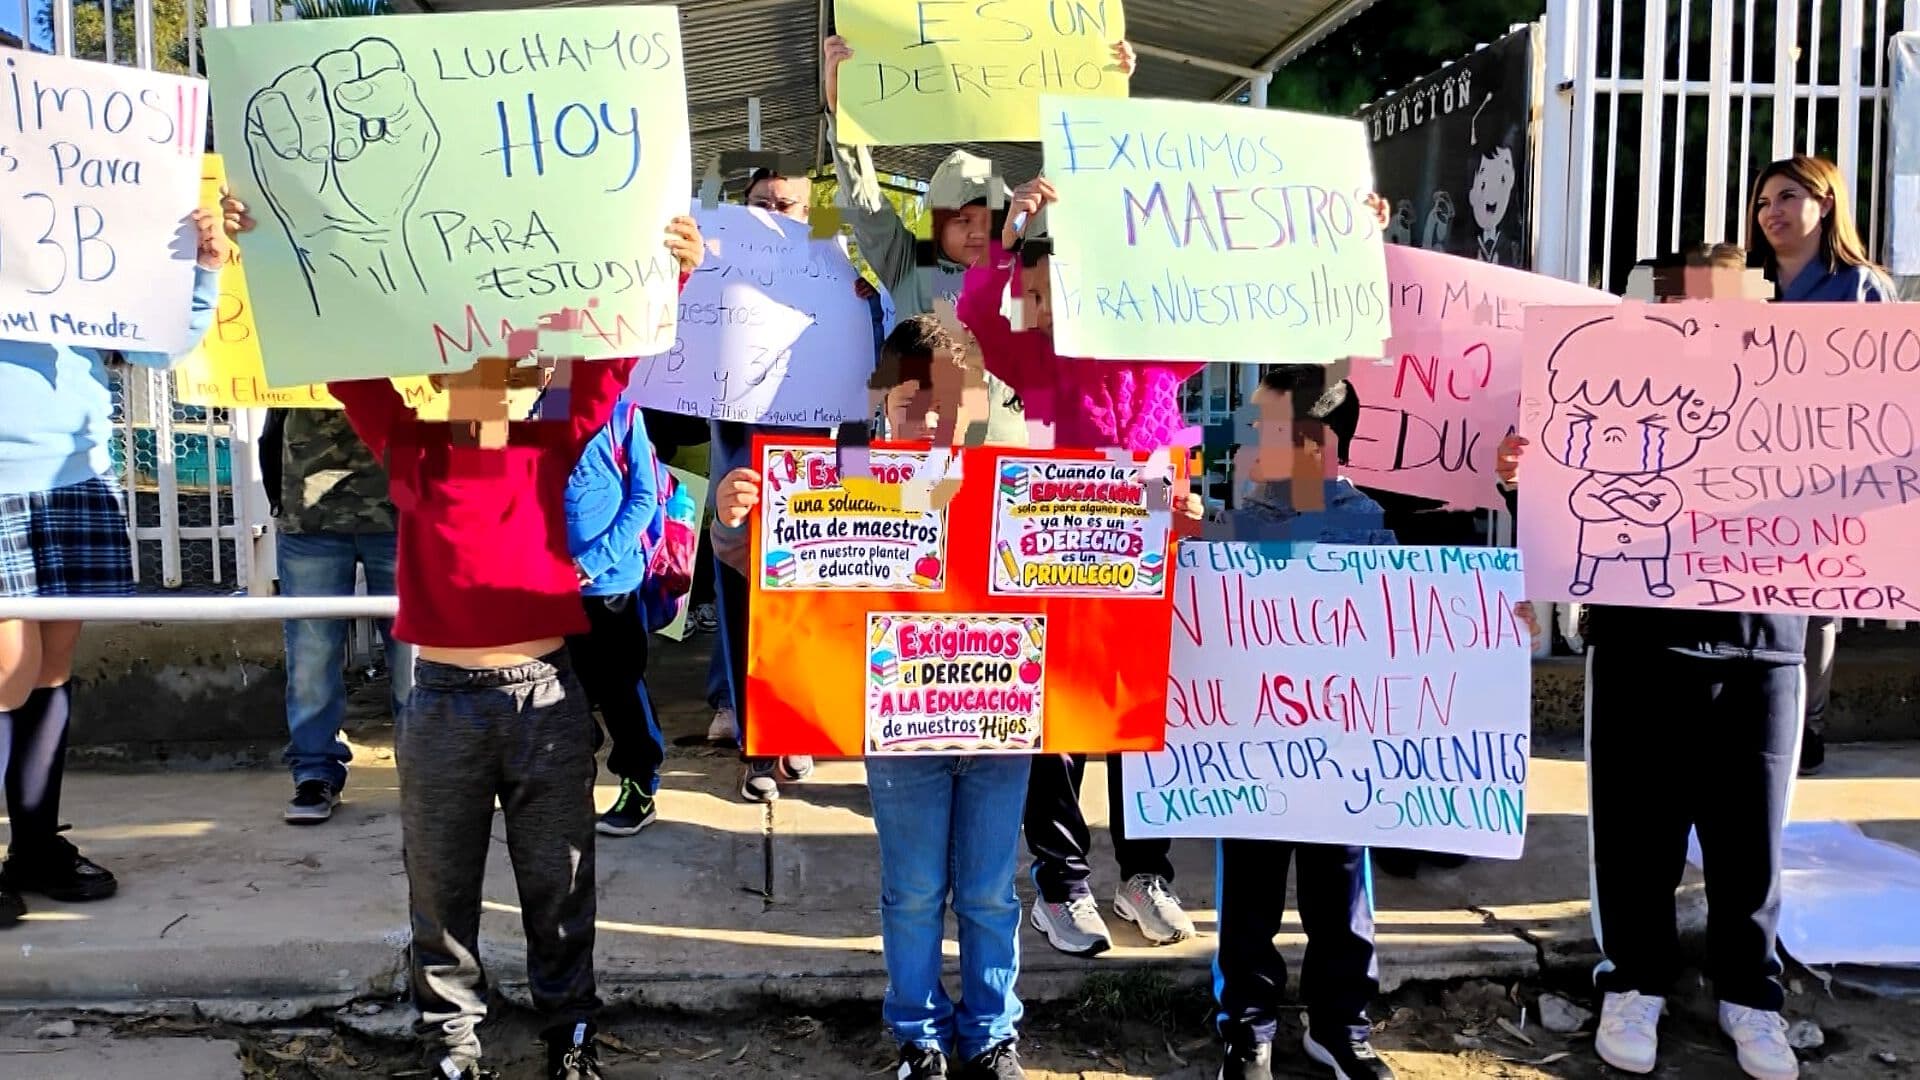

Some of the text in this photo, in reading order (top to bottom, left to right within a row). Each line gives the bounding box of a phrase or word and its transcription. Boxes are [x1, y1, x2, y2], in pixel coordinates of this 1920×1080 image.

[903, 1, 1033, 50] ES
[432, 30, 671, 80] LUCHAMOS
[858, 48, 1102, 106] DERECHO
[1050, 112, 1284, 178] EXIGIMOS
[49, 141, 140, 188] Para
[1123, 181, 1374, 253] MAESTROS
[22, 193, 116, 294] 3B
[420, 210, 560, 262] PARA
[1152, 268, 1308, 327] NUESTROS
[50, 312, 145, 341] Mendez
[1736, 397, 1914, 458] QUIERO
[807, 457, 914, 488] Exmos
[1045, 464, 1125, 481] Cuando la
[1694, 464, 1920, 504] ESTUDIAR
[794, 498, 824, 513] una
[1053, 505, 1077, 514] para
[1080, 504, 1117, 515] algunos
[774, 518, 938, 544] falta de maestros
[1041, 515, 1125, 530] ya No es un
[1684, 510, 1866, 547] PERO NO
[800, 546, 910, 562] en nuestro plantel
[1036, 530, 1130, 553] DERECHO
[1062, 552, 1095, 562] es un
[819, 560, 891, 579] educativo
[1023, 562, 1135, 587] PRIVILEGIO
[1440, 547, 1525, 574] Mendez
[1674, 551, 1866, 581] TENEMOS
[1696, 579, 1920, 612] DIRECTOR
[1221, 573, 1368, 650] HUELGA
[1381, 567, 1522, 659] HASTA
[897, 623, 1022, 660] Exigimos
[904, 662, 1012, 685] el DERECHO
[880, 686, 1033, 715] A LA EDUCACIÓN
[1165, 671, 1457, 736] QUE ASIGNEN
[883, 719, 903, 738] de
[907, 717, 977, 736] nuestros
[1144, 735, 1342, 789] DIRECTOR
[1373, 730, 1528, 785] DOCENTES
[1136, 782, 1288, 826] EXIGIMOS
